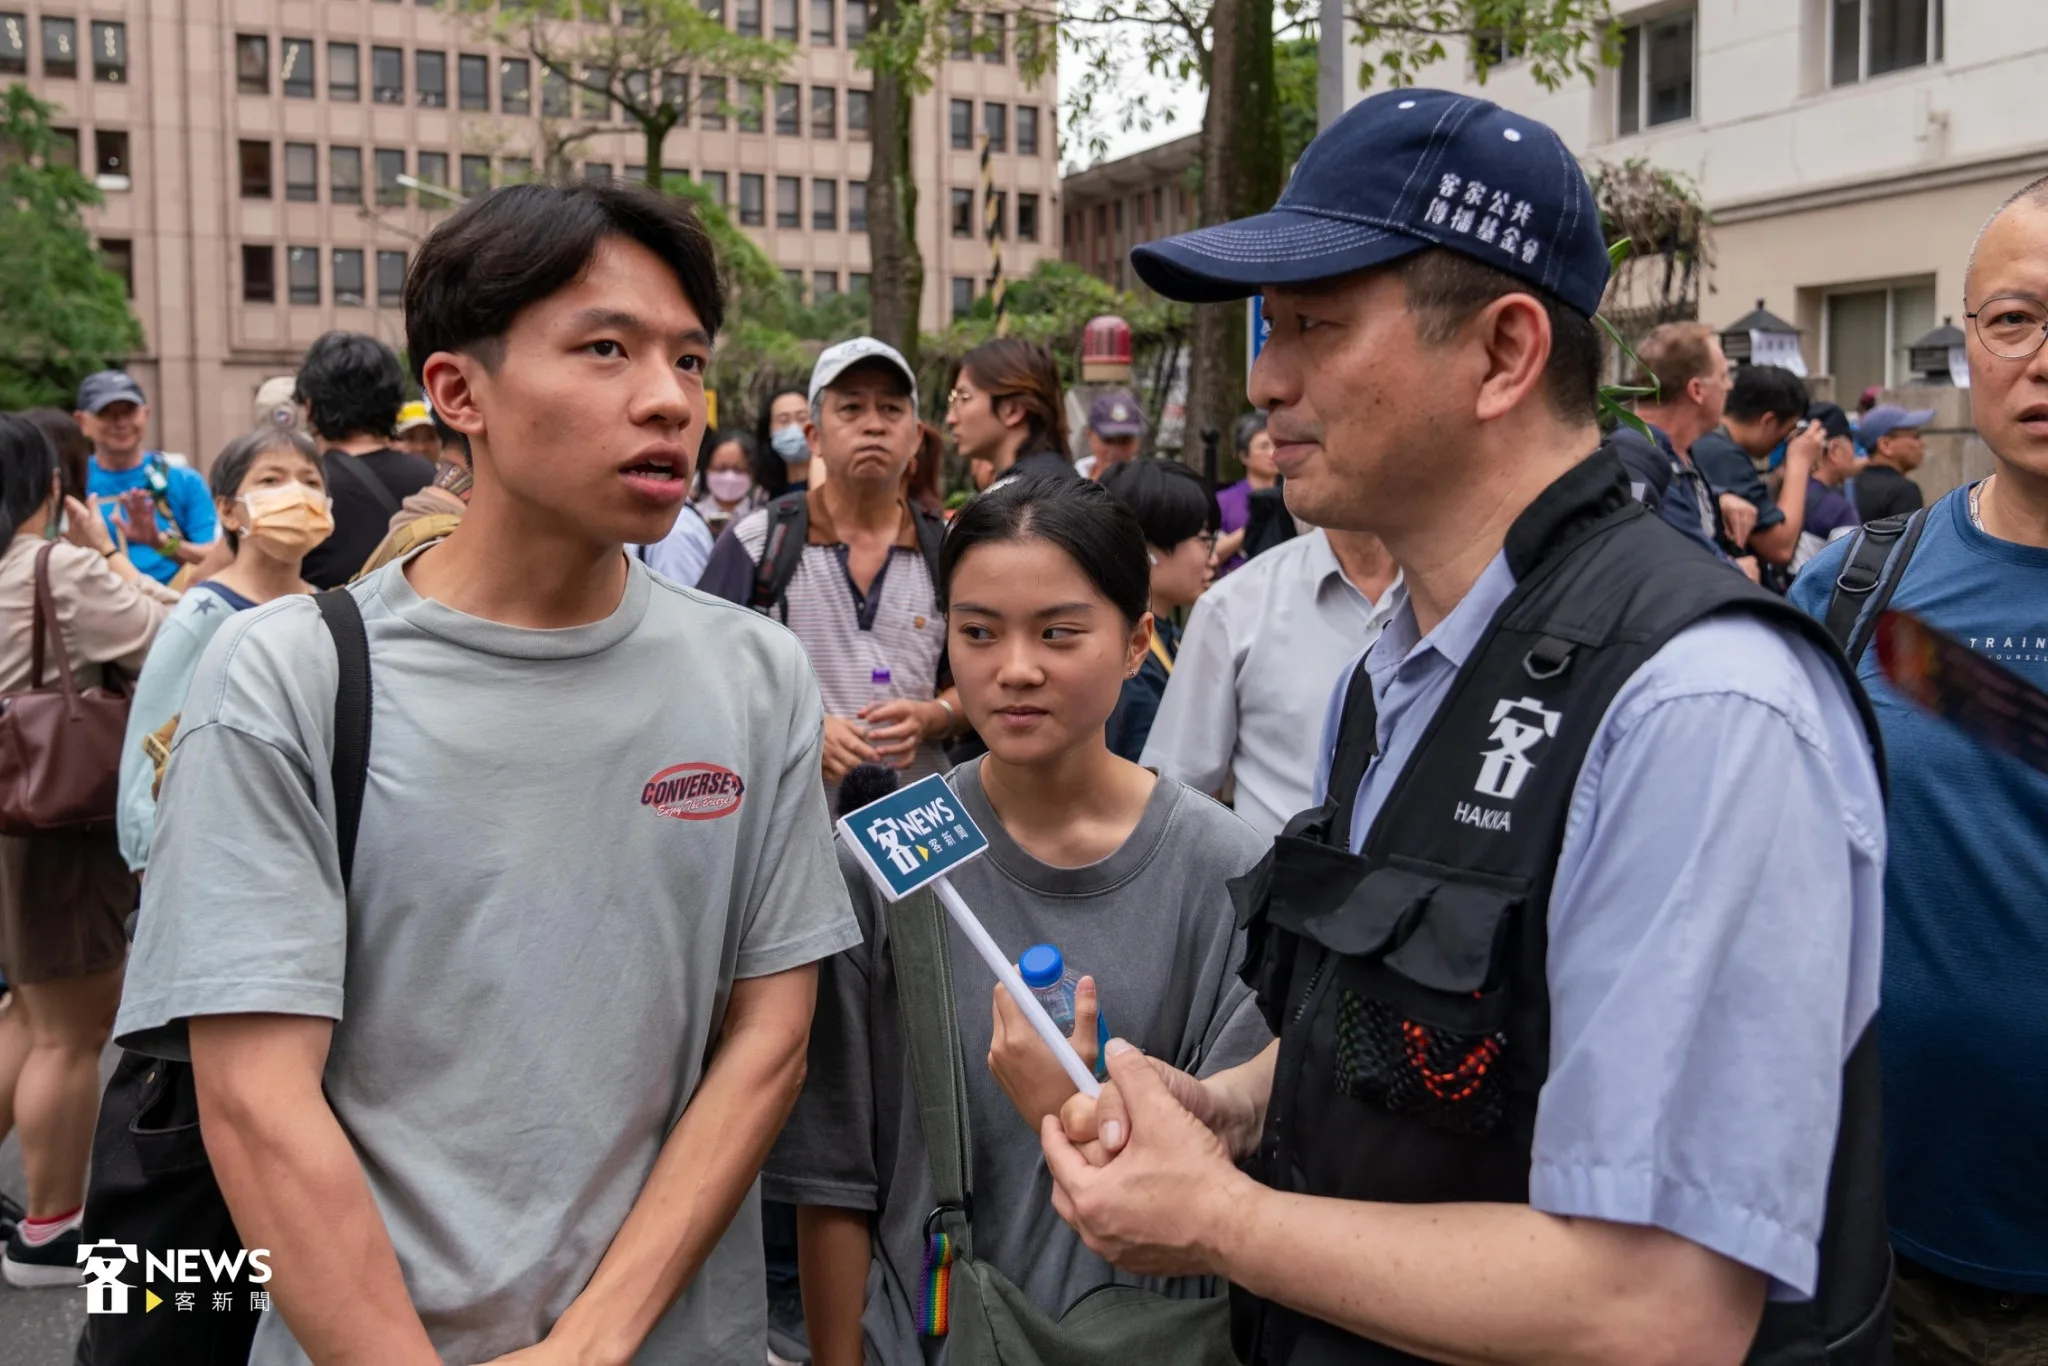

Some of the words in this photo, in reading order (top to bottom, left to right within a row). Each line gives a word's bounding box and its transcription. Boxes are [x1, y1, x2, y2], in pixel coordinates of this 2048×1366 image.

[1438, 173, 1534, 228] 客家公共
[1969, 636, 2046, 649] TRAIN
[640, 771, 734, 806] CONVERSE
[656, 804, 683, 818] Enjoy
[684, 799, 701, 811] The
[702, 795, 733, 808] Breeze!
[897, 797, 955, 842] NEWS
[1453, 800, 1512, 833] HAKKA
[928, 823, 969, 855] 客新聞
